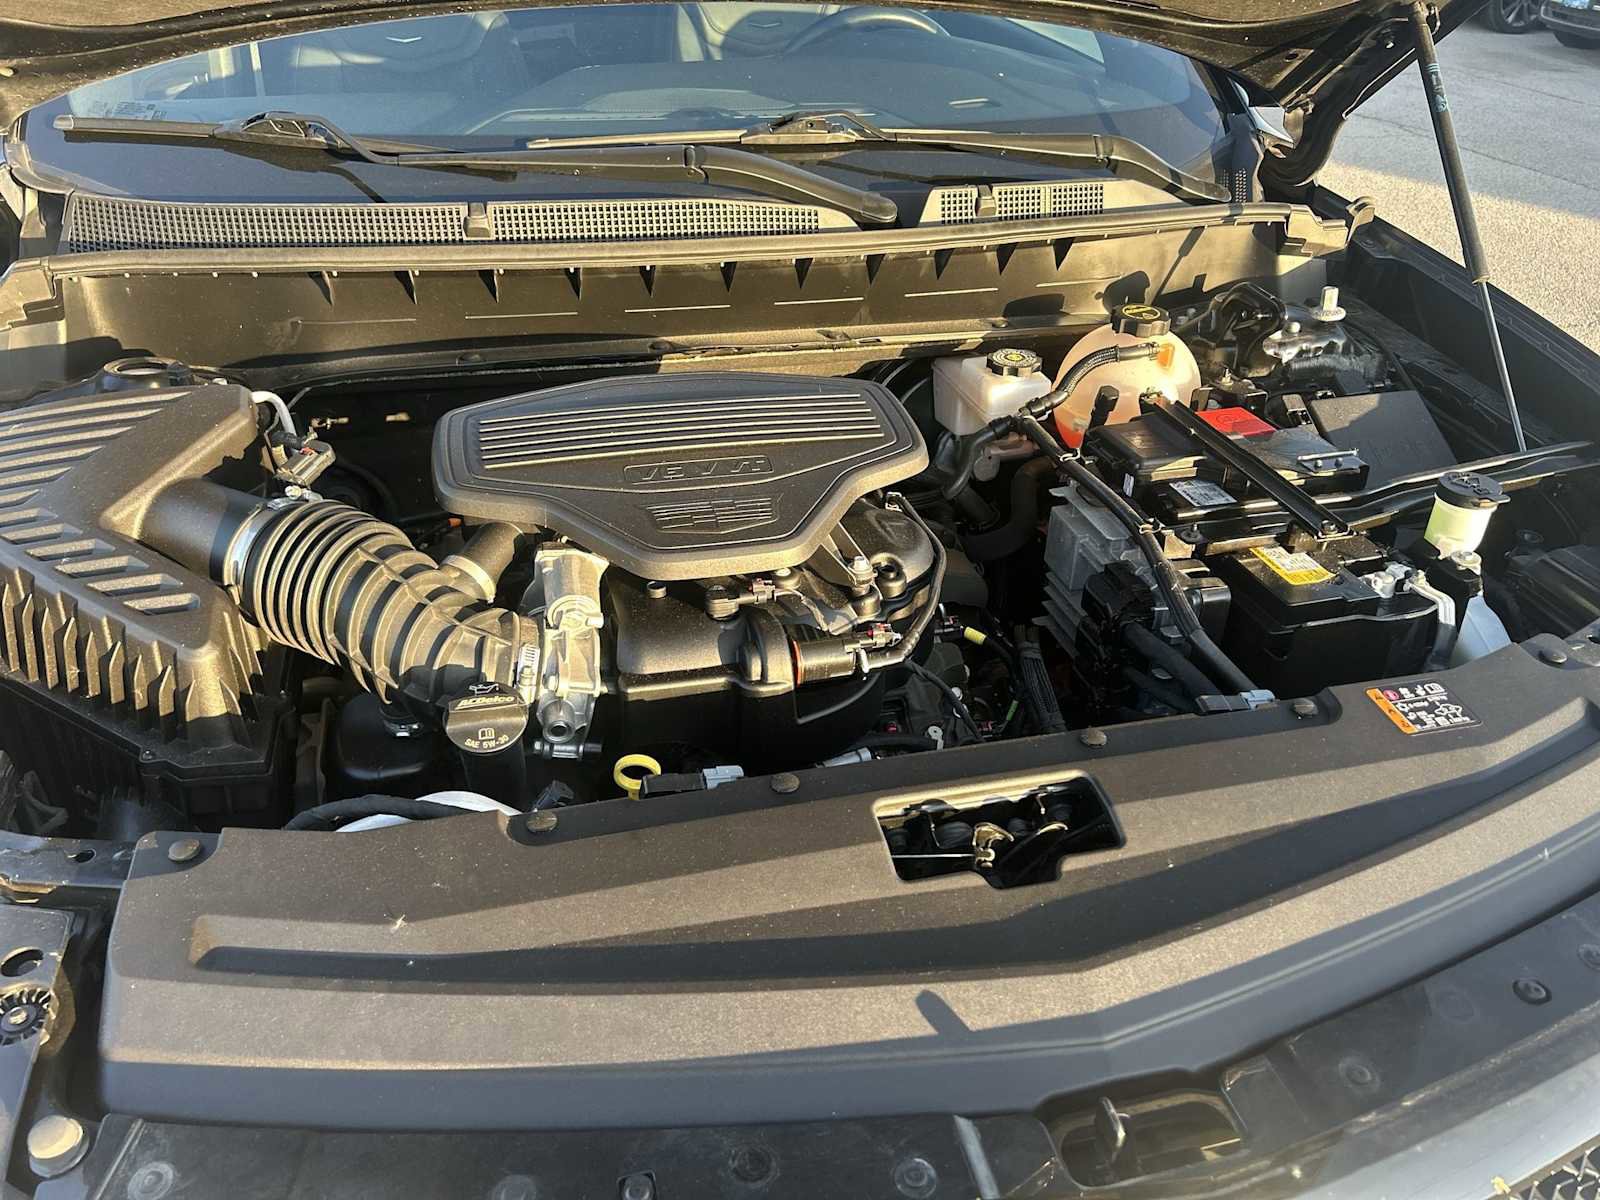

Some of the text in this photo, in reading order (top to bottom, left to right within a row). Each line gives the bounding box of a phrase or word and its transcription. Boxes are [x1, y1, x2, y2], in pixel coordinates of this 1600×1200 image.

[456, 695, 515, 708] ACDelco
[464, 734, 509, 749] SAE 5W-30
